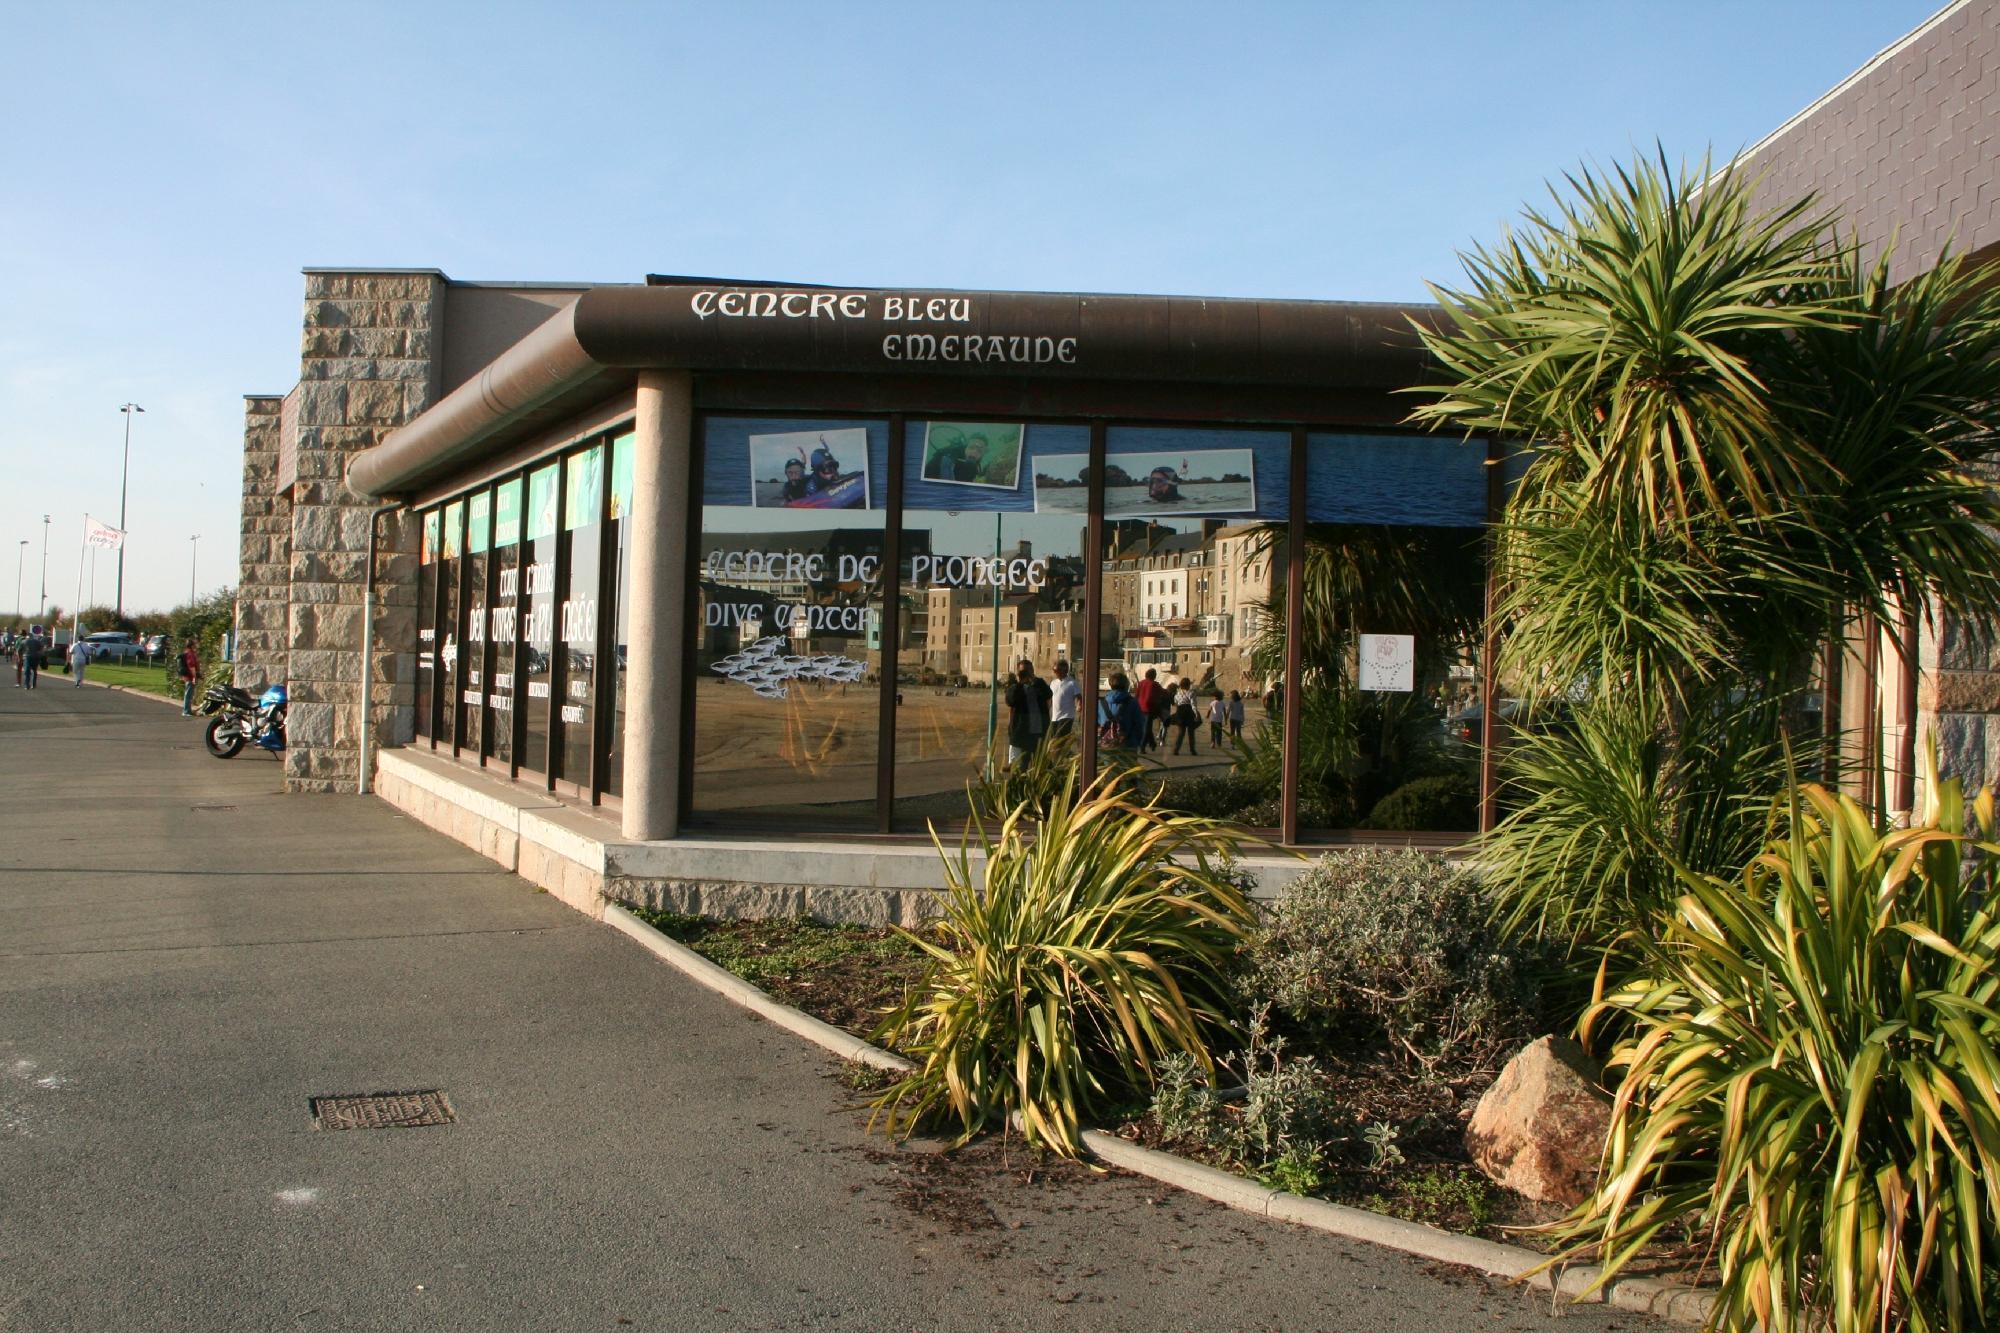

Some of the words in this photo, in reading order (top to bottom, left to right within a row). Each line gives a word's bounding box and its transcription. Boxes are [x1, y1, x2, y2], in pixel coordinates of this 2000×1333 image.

[690, 291, 868, 321] CENTRE
[883, 295, 971, 323] BLEU
[882, 333, 1077, 365] EMERAUDE
[706, 549, 825, 583] CENTRE
[838, 552, 878, 584] DE
[911, 554, 1047, 588] PLONGEE
[705, 602, 763, 628] DIVE
[774, 603, 875, 632] CENTER
